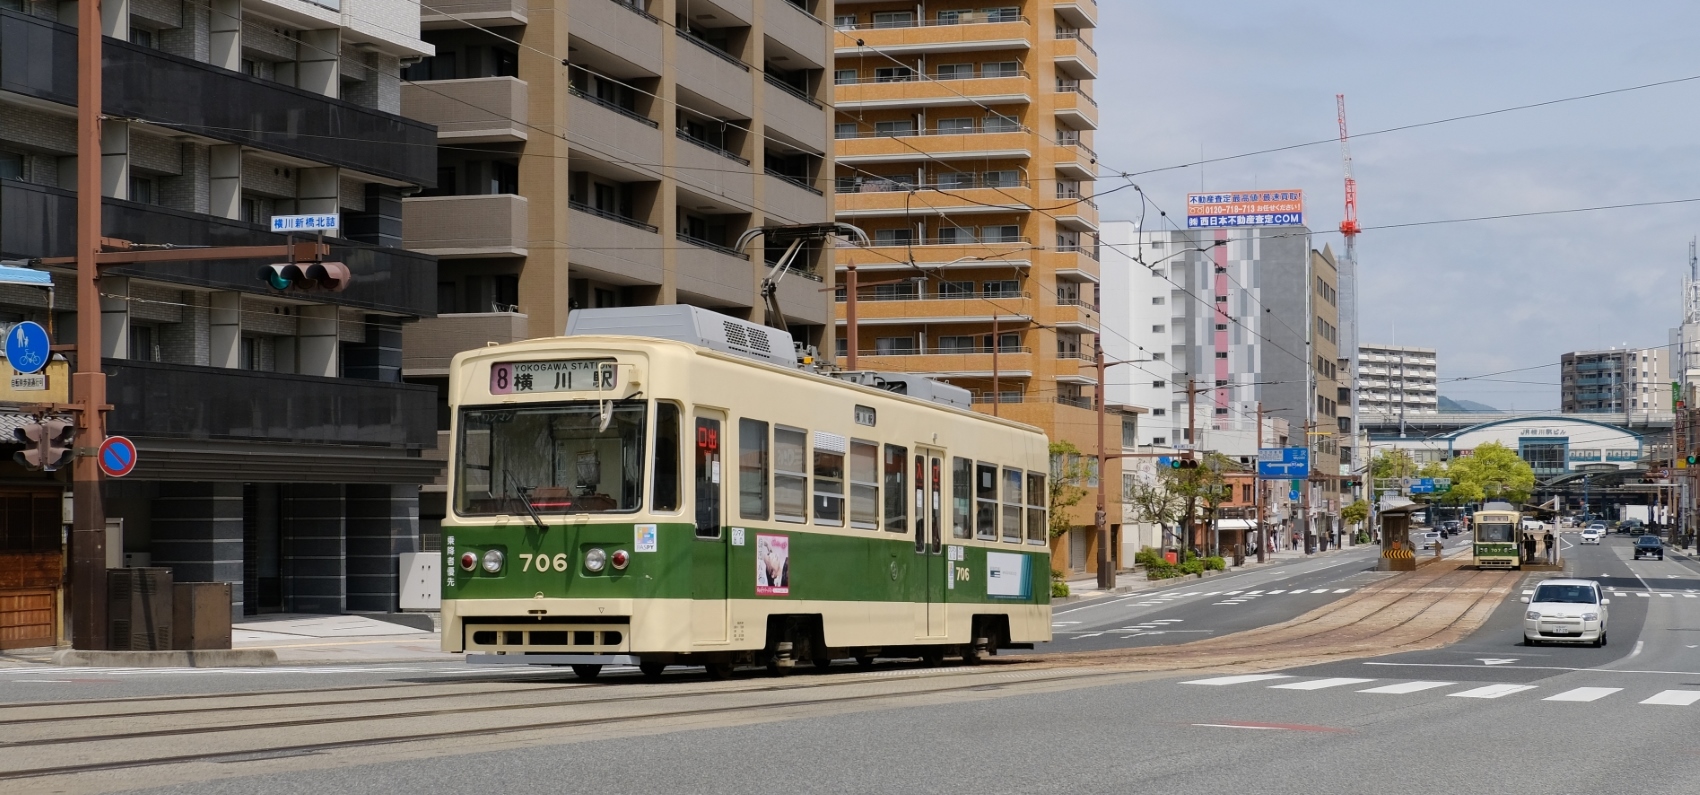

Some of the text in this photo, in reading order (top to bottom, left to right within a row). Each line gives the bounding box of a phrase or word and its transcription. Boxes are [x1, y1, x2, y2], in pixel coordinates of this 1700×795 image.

[274, 216, 335, 229] 横川新橋北詰
[514, 362, 568, 372] YOKOGAWA
[497, 367, 508, 389] 8
[519, 553, 568, 572] 706
[955, 566, 970, 581] 706
